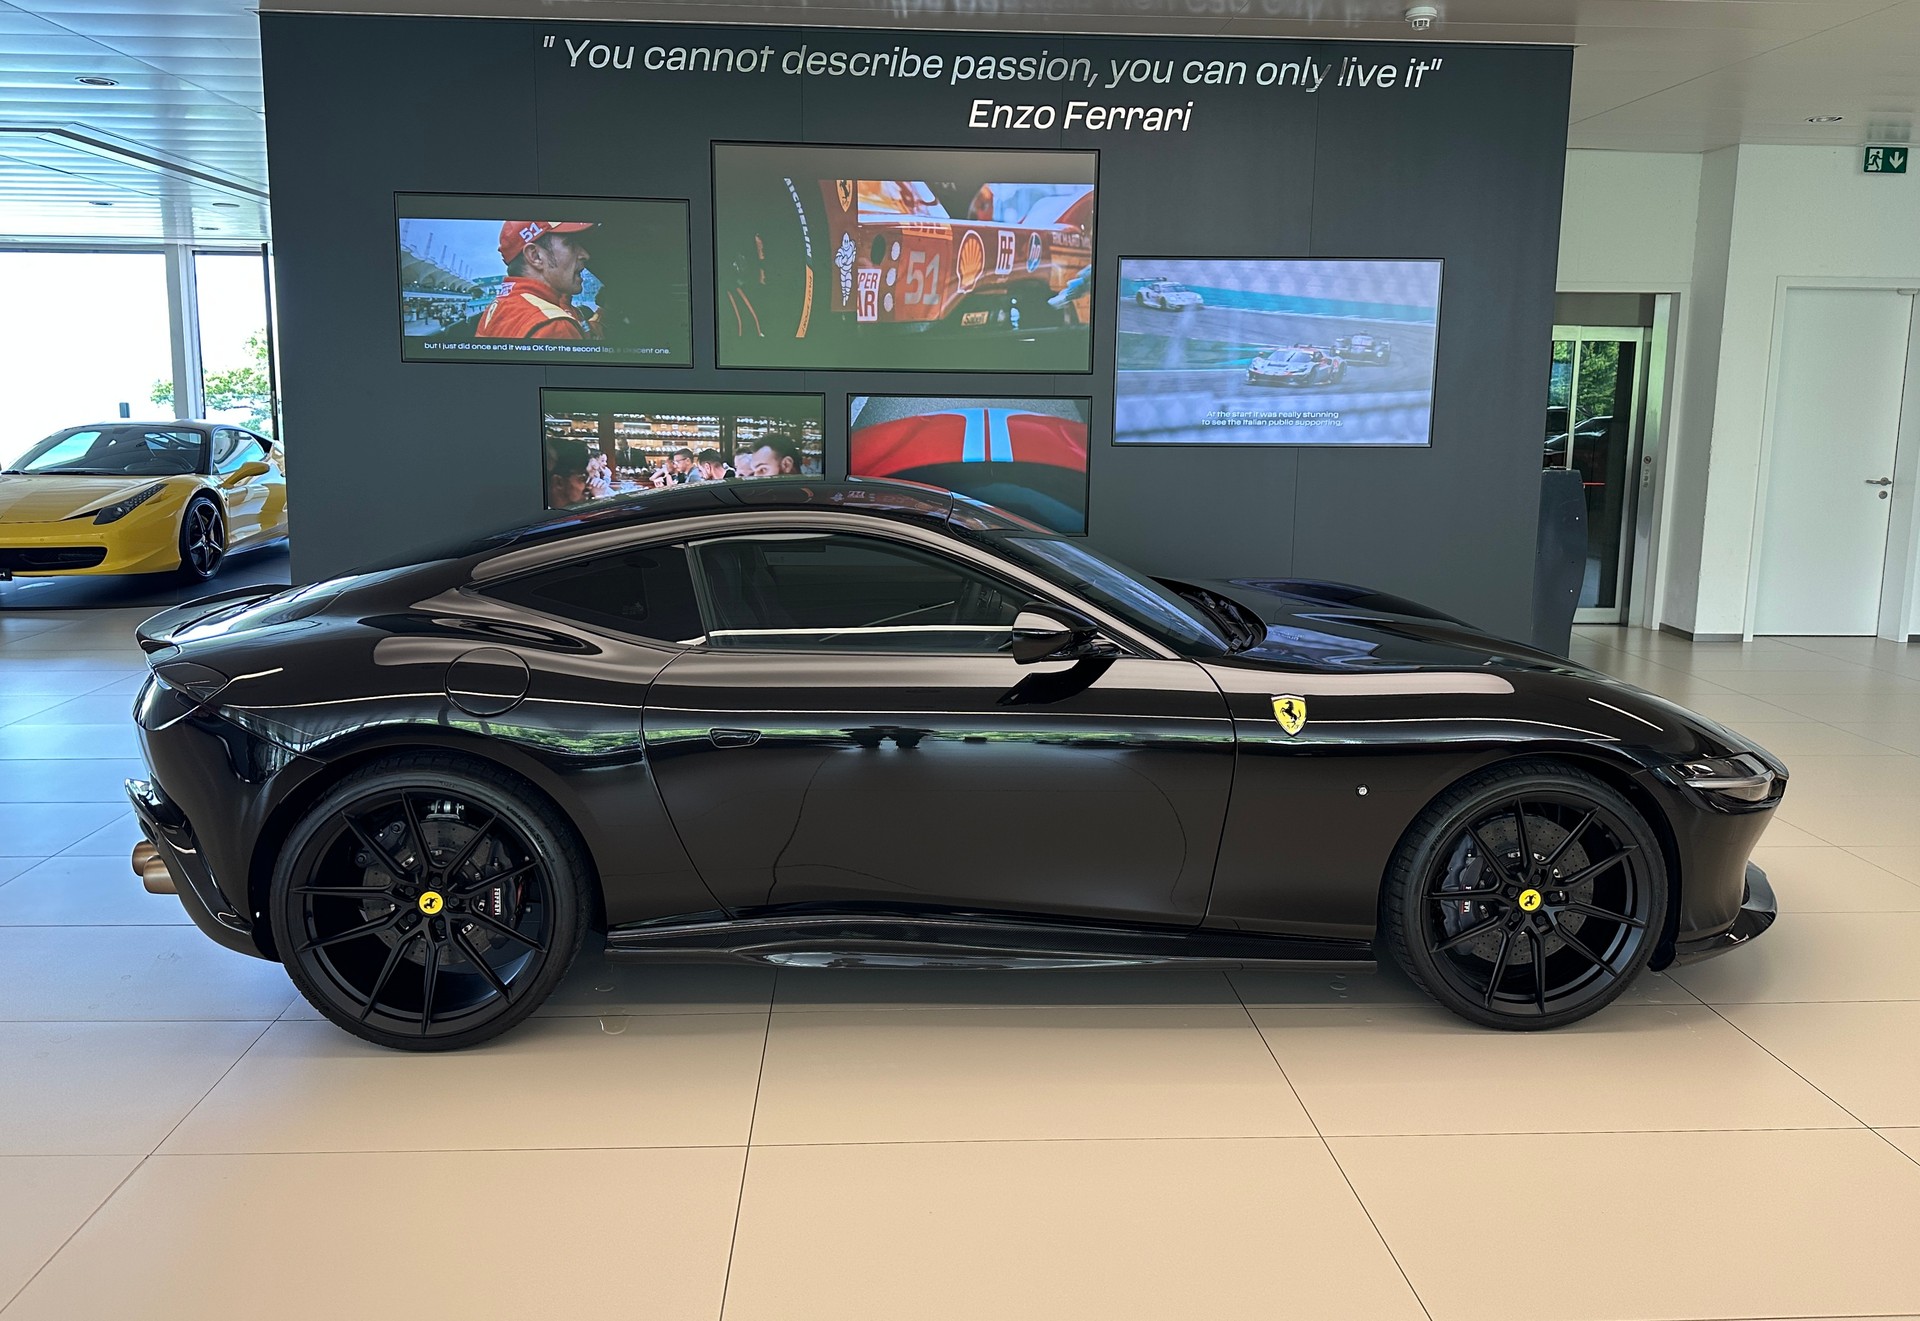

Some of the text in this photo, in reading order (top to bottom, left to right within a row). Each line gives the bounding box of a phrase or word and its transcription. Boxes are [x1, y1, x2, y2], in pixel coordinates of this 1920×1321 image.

[564, 38, 635, 70] You
[644, 45, 775, 73] cannot
[781, 44, 944, 79] describe
[950, 50, 1099, 88] passion,
[1104, 59, 1174, 89] you
[1182, 60, 1247, 85] can
[1256, 56, 1329, 93] only
[1337, 56, 1398, 88] live
[1404, 57, 1443, 88] it"
[968, 99, 1194, 132] Enzo Ferrari
[519, 222, 543, 243] 51
[904, 250, 940, 305] 51
[424, 342, 438, 350] but
[443, 343, 457, 351] just
[458, 342, 470, 351] did
[515, 344, 531, 352] was
[532, 344, 545, 352] OK
[545, 344, 557, 352] for
[572, 345, 601, 353] second
[654, 347, 671, 355] one.
[1242, 418, 1267, 426] Italian
[1268, 418, 1294, 427] public
[1278, 411, 1302, 421] really
[1302, 411, 1339, 421] stunning
